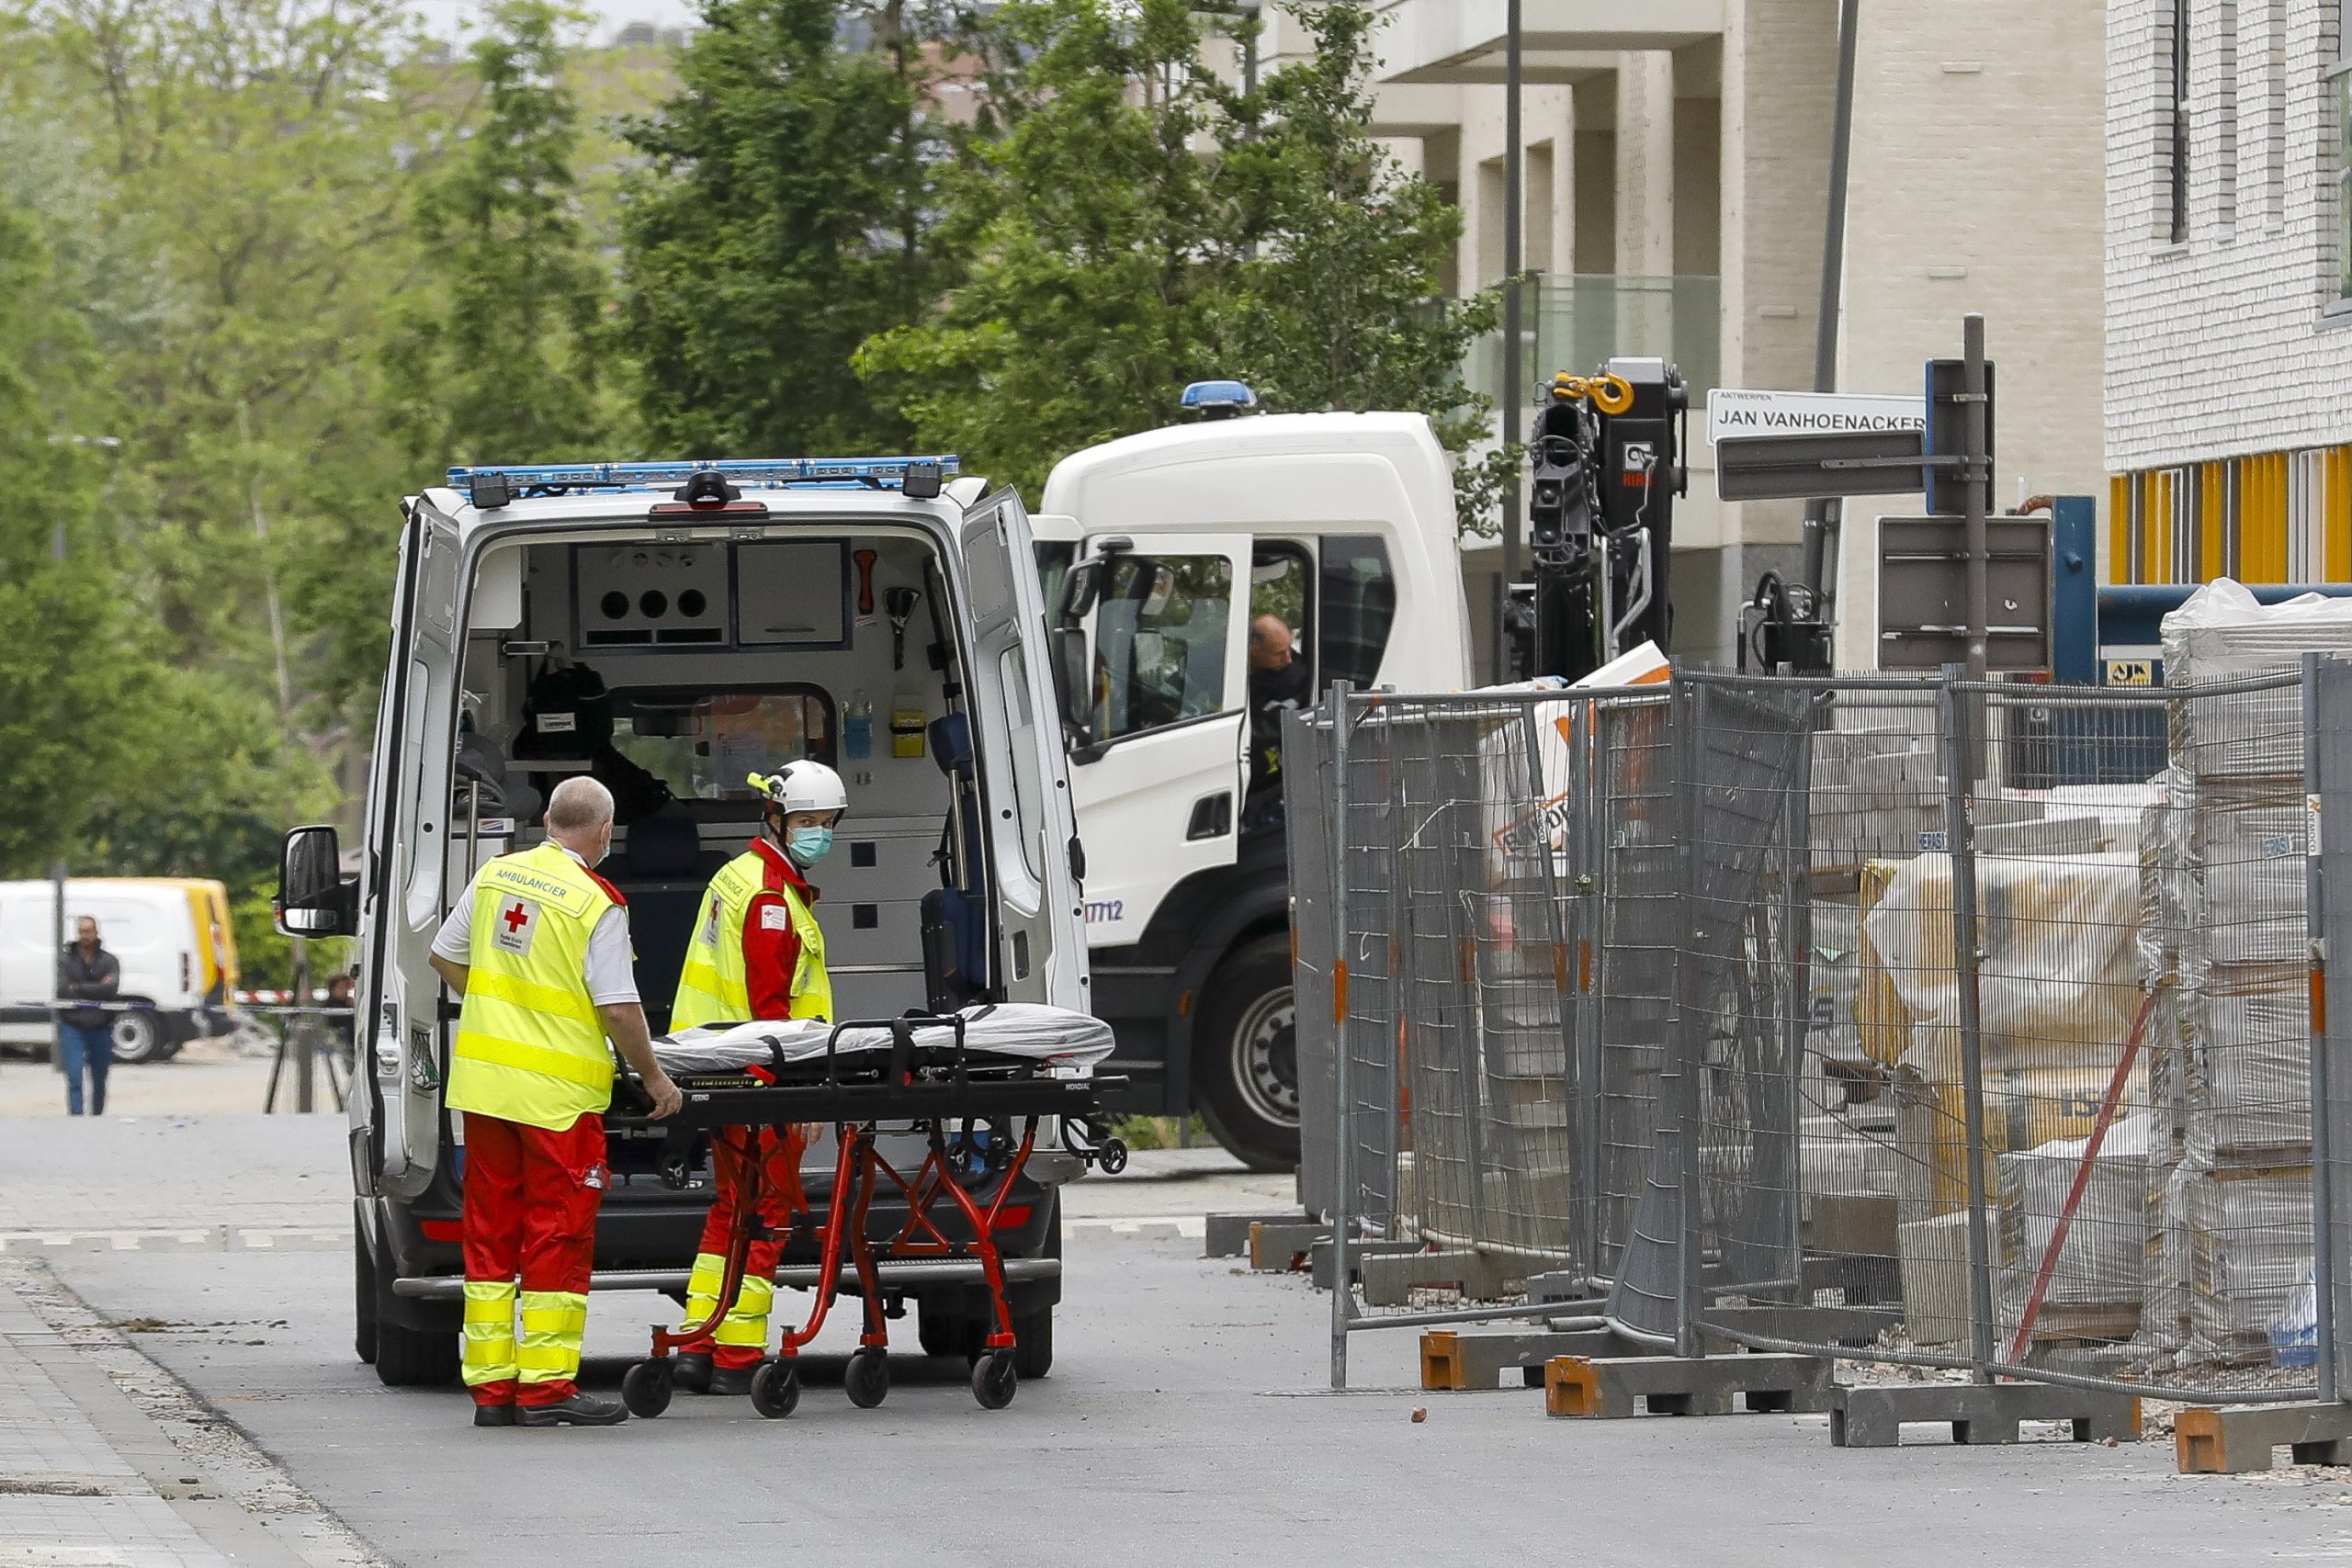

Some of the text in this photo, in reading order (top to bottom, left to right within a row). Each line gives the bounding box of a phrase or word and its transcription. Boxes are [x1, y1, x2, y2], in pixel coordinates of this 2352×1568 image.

[1720, 391, 1772, 401] ANTWERPEN
[1719, 410, 1926, 430] JAN VANHOENACKER
[2307, 810, 2317, 853] DEMOCO
[495, 869, 567, 899] AMBULANCIER
